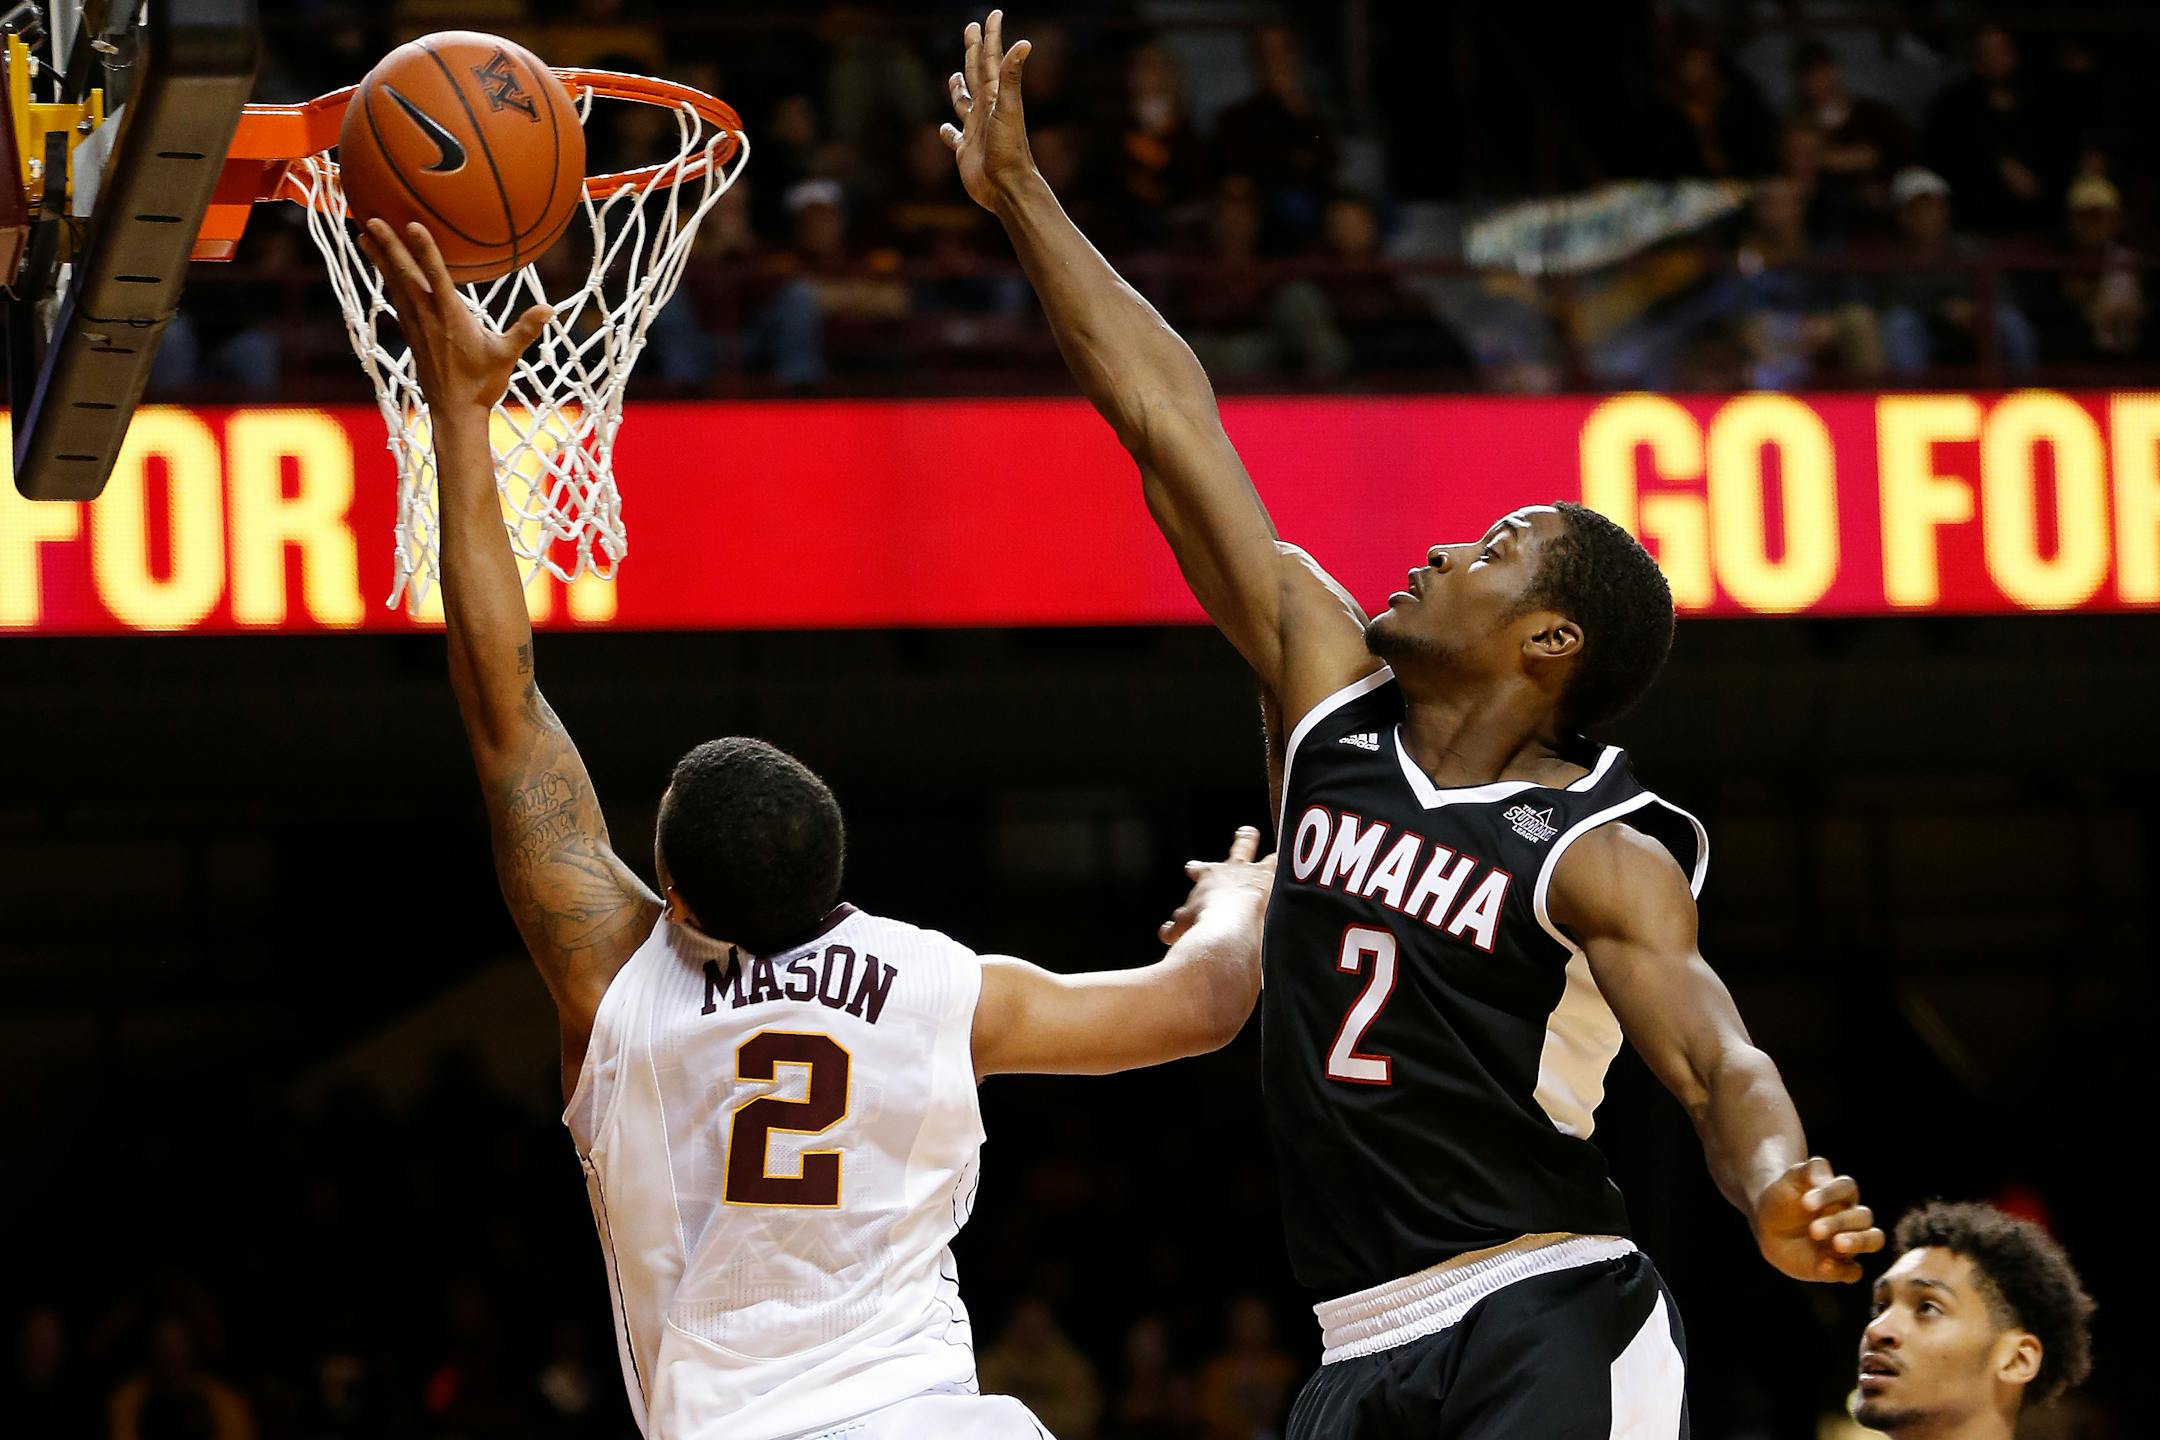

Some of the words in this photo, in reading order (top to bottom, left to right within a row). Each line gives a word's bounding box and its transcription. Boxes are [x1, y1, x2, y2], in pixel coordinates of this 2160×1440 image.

[1579, 392, 1839, 614] GO
[1339, 737, 1380, 751] adidas
[1293, 804, 1512, 953] OMAHA
[1512, 825, 1539, 843] LEAGUE
[701, 944, 898, 1024] MASON
[1325, 922, 1398, 1085] 2
[723, 1030, 852, 1209] 2
